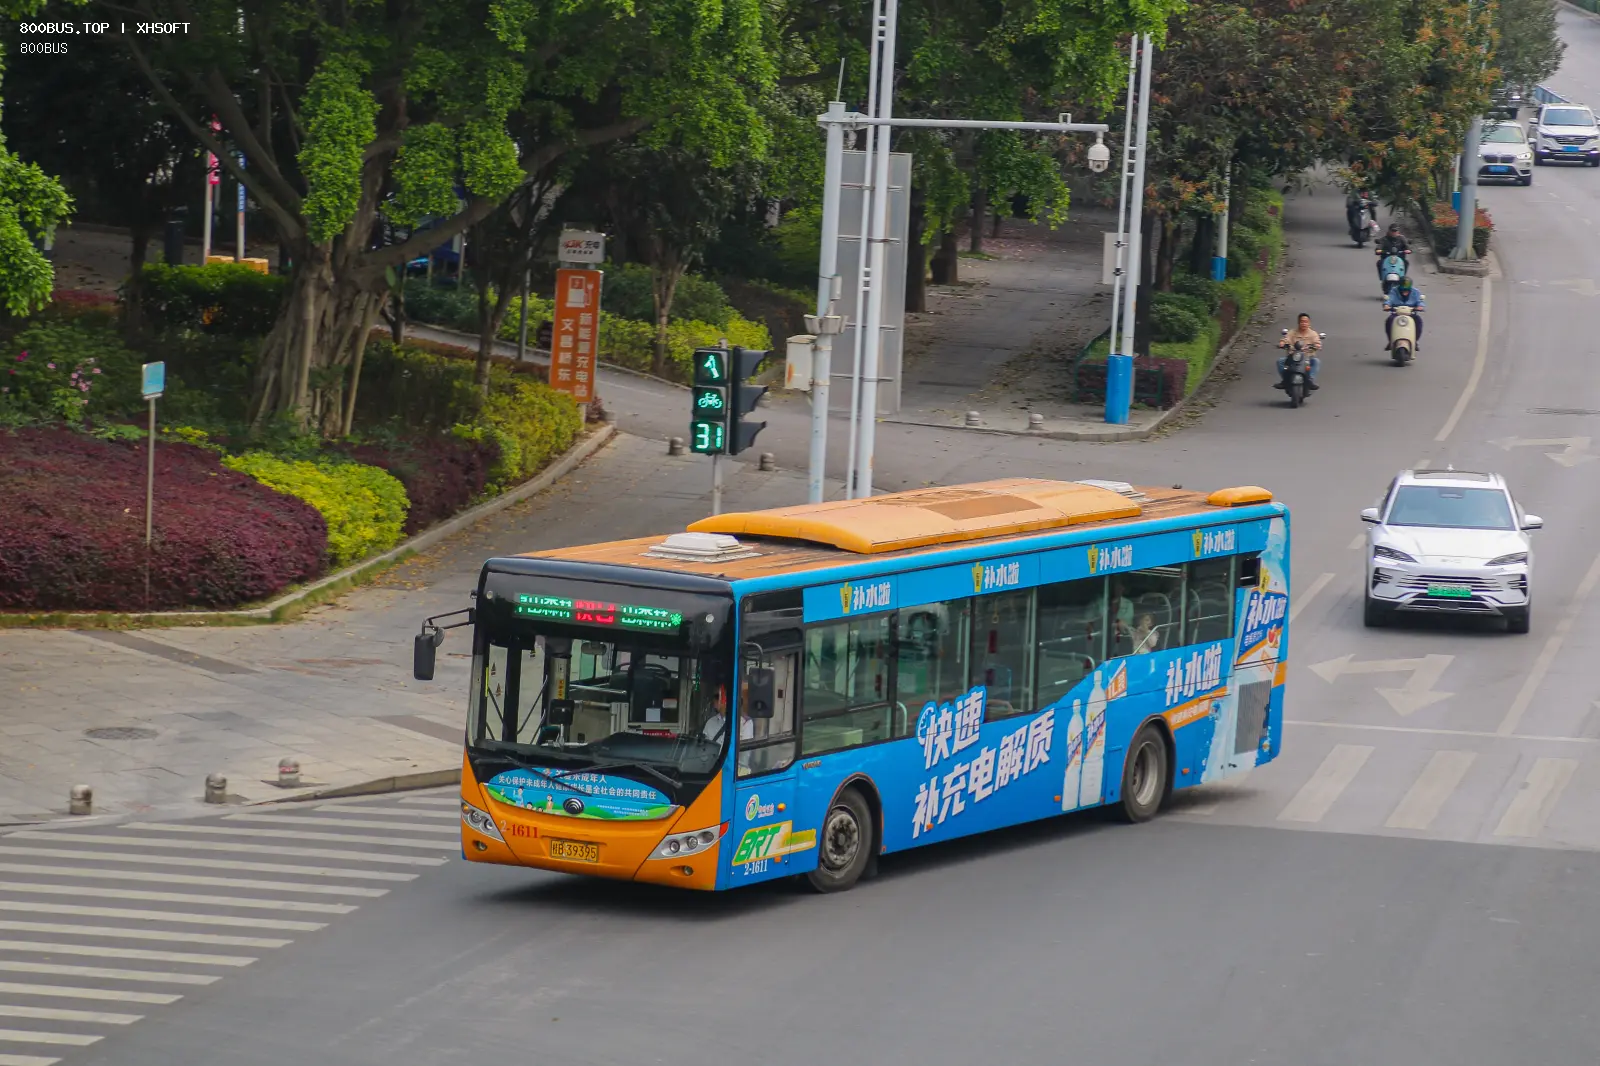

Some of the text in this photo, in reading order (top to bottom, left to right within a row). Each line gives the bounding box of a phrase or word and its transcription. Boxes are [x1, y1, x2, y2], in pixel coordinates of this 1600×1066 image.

[696, 423, 722, 449] 31
[1203, 528, 1235, 555] 补水啦
[1099, 544, 1133, 571] 补水啦
[984, 561, 1019, 589] 补水啦
[853, 581, 890, 611] 补水啦
[1165, 642, 1222, 707] 补水啦
[917, 690, 984, 770] 快速
[912, 708, 1056, 839] 补充电解质
[500, 819, 539, 839] 2-1611
[734, 825, 782, 863] BRT
[743, 859, 768, 876] 2-1611
